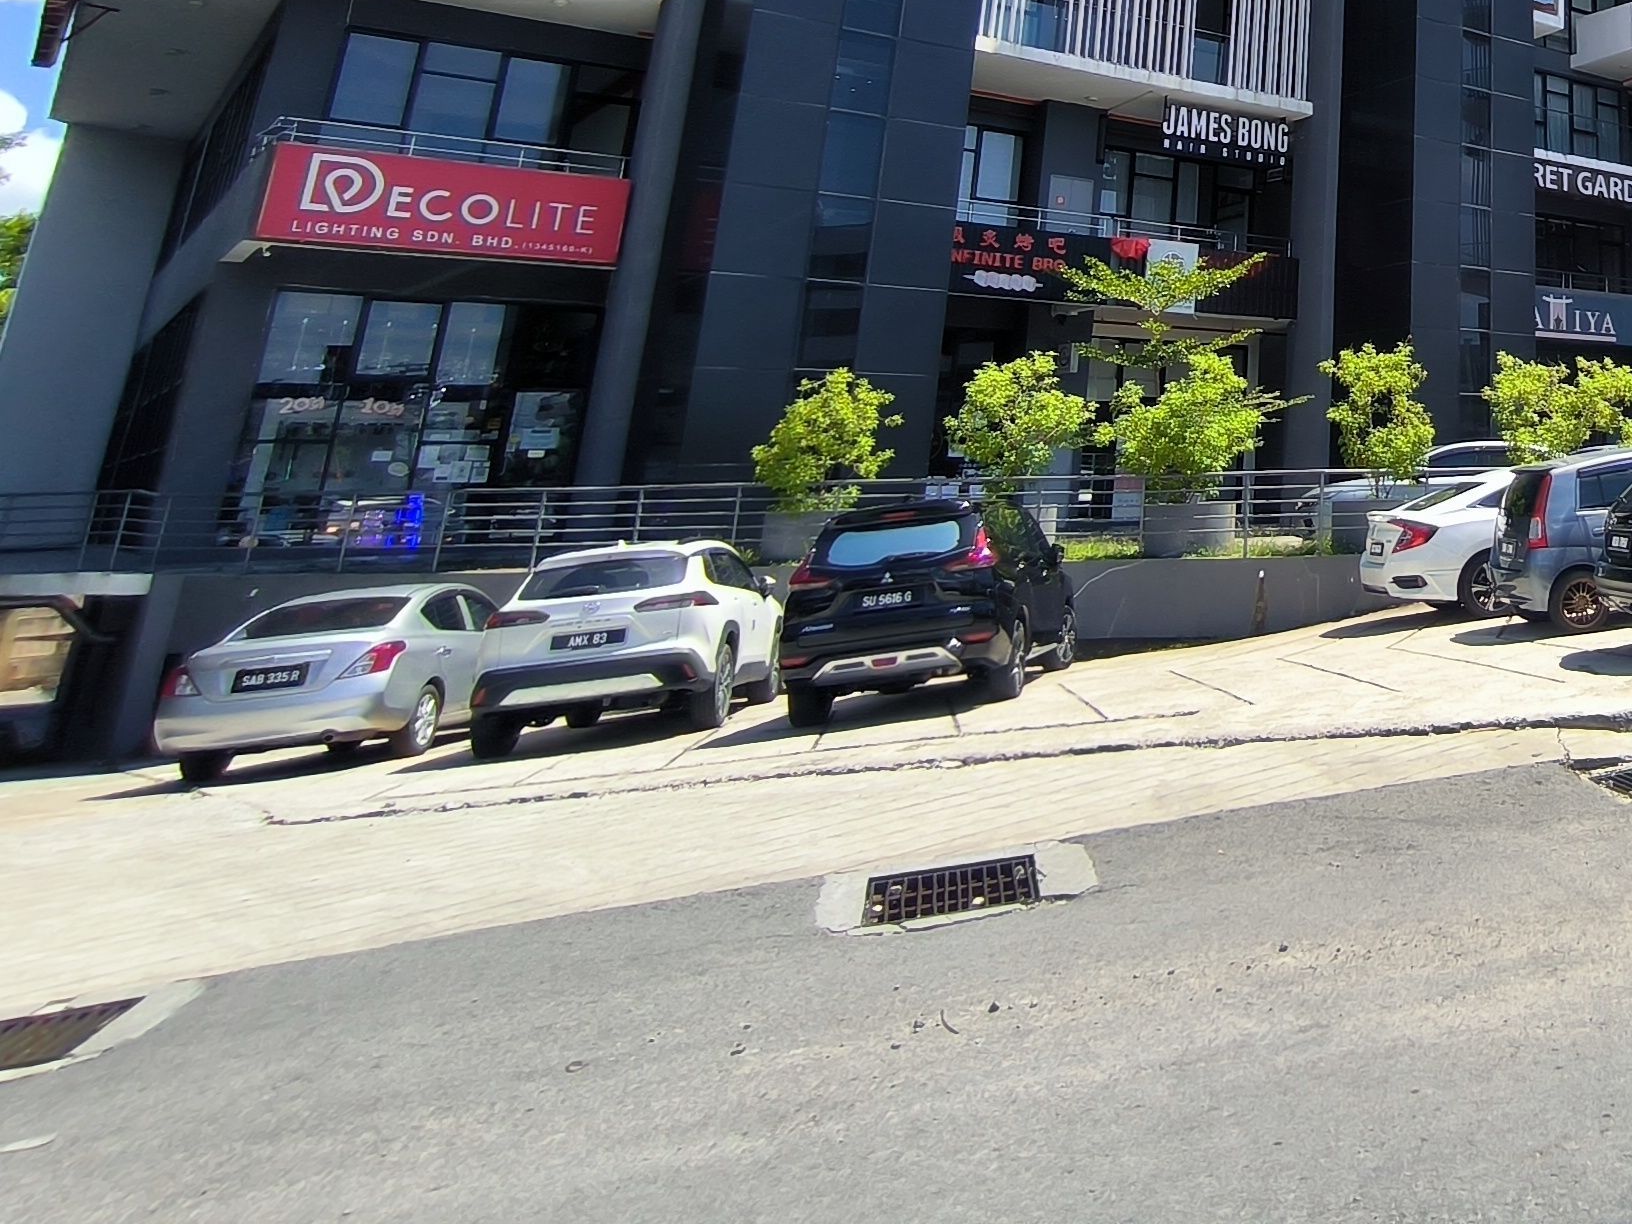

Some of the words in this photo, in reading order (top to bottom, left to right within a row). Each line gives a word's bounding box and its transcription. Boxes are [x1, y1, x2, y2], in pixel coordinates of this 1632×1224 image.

[1162, 103, 1232, 144] JAMES
[1237, 116, 1289, 153] BONG
[1163, 138, 1206, 154] HAIR
[1222, 147, 1285, 166] STUDIO
[291, 220, 400, 240] LIGHTING
[412, 229, 460, 245] SDN.
[472, 233, 519, 249] BHD.
[862, 595, 877, 607] SU
[878, 592, 903, 605] 5616
[904, 590, 912, 602] G
[567, 634, 590, 647] AMX
[592, 632, 608, 644] 83
[241, 674, 265, 687] SAB
